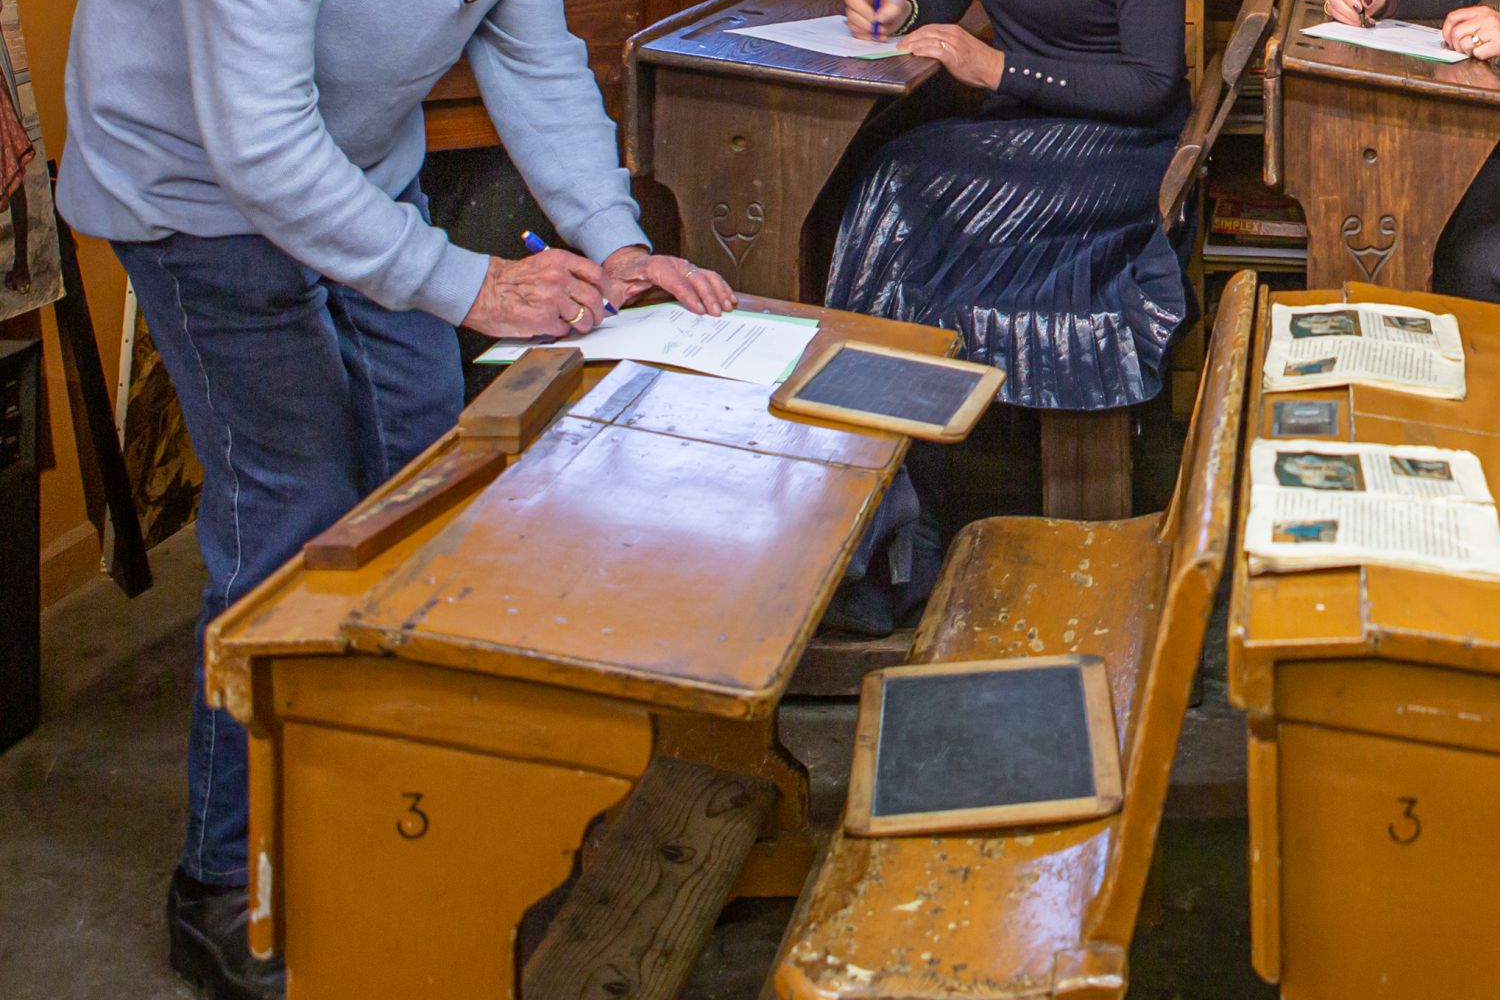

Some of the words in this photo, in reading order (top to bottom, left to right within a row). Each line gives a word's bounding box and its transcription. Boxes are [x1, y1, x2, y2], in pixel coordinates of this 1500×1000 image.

[1213, 219, 1260, 232] SIMPLEX
[397, 793, 429, 840] 3
[1388, 798, 1421, 844] 3
